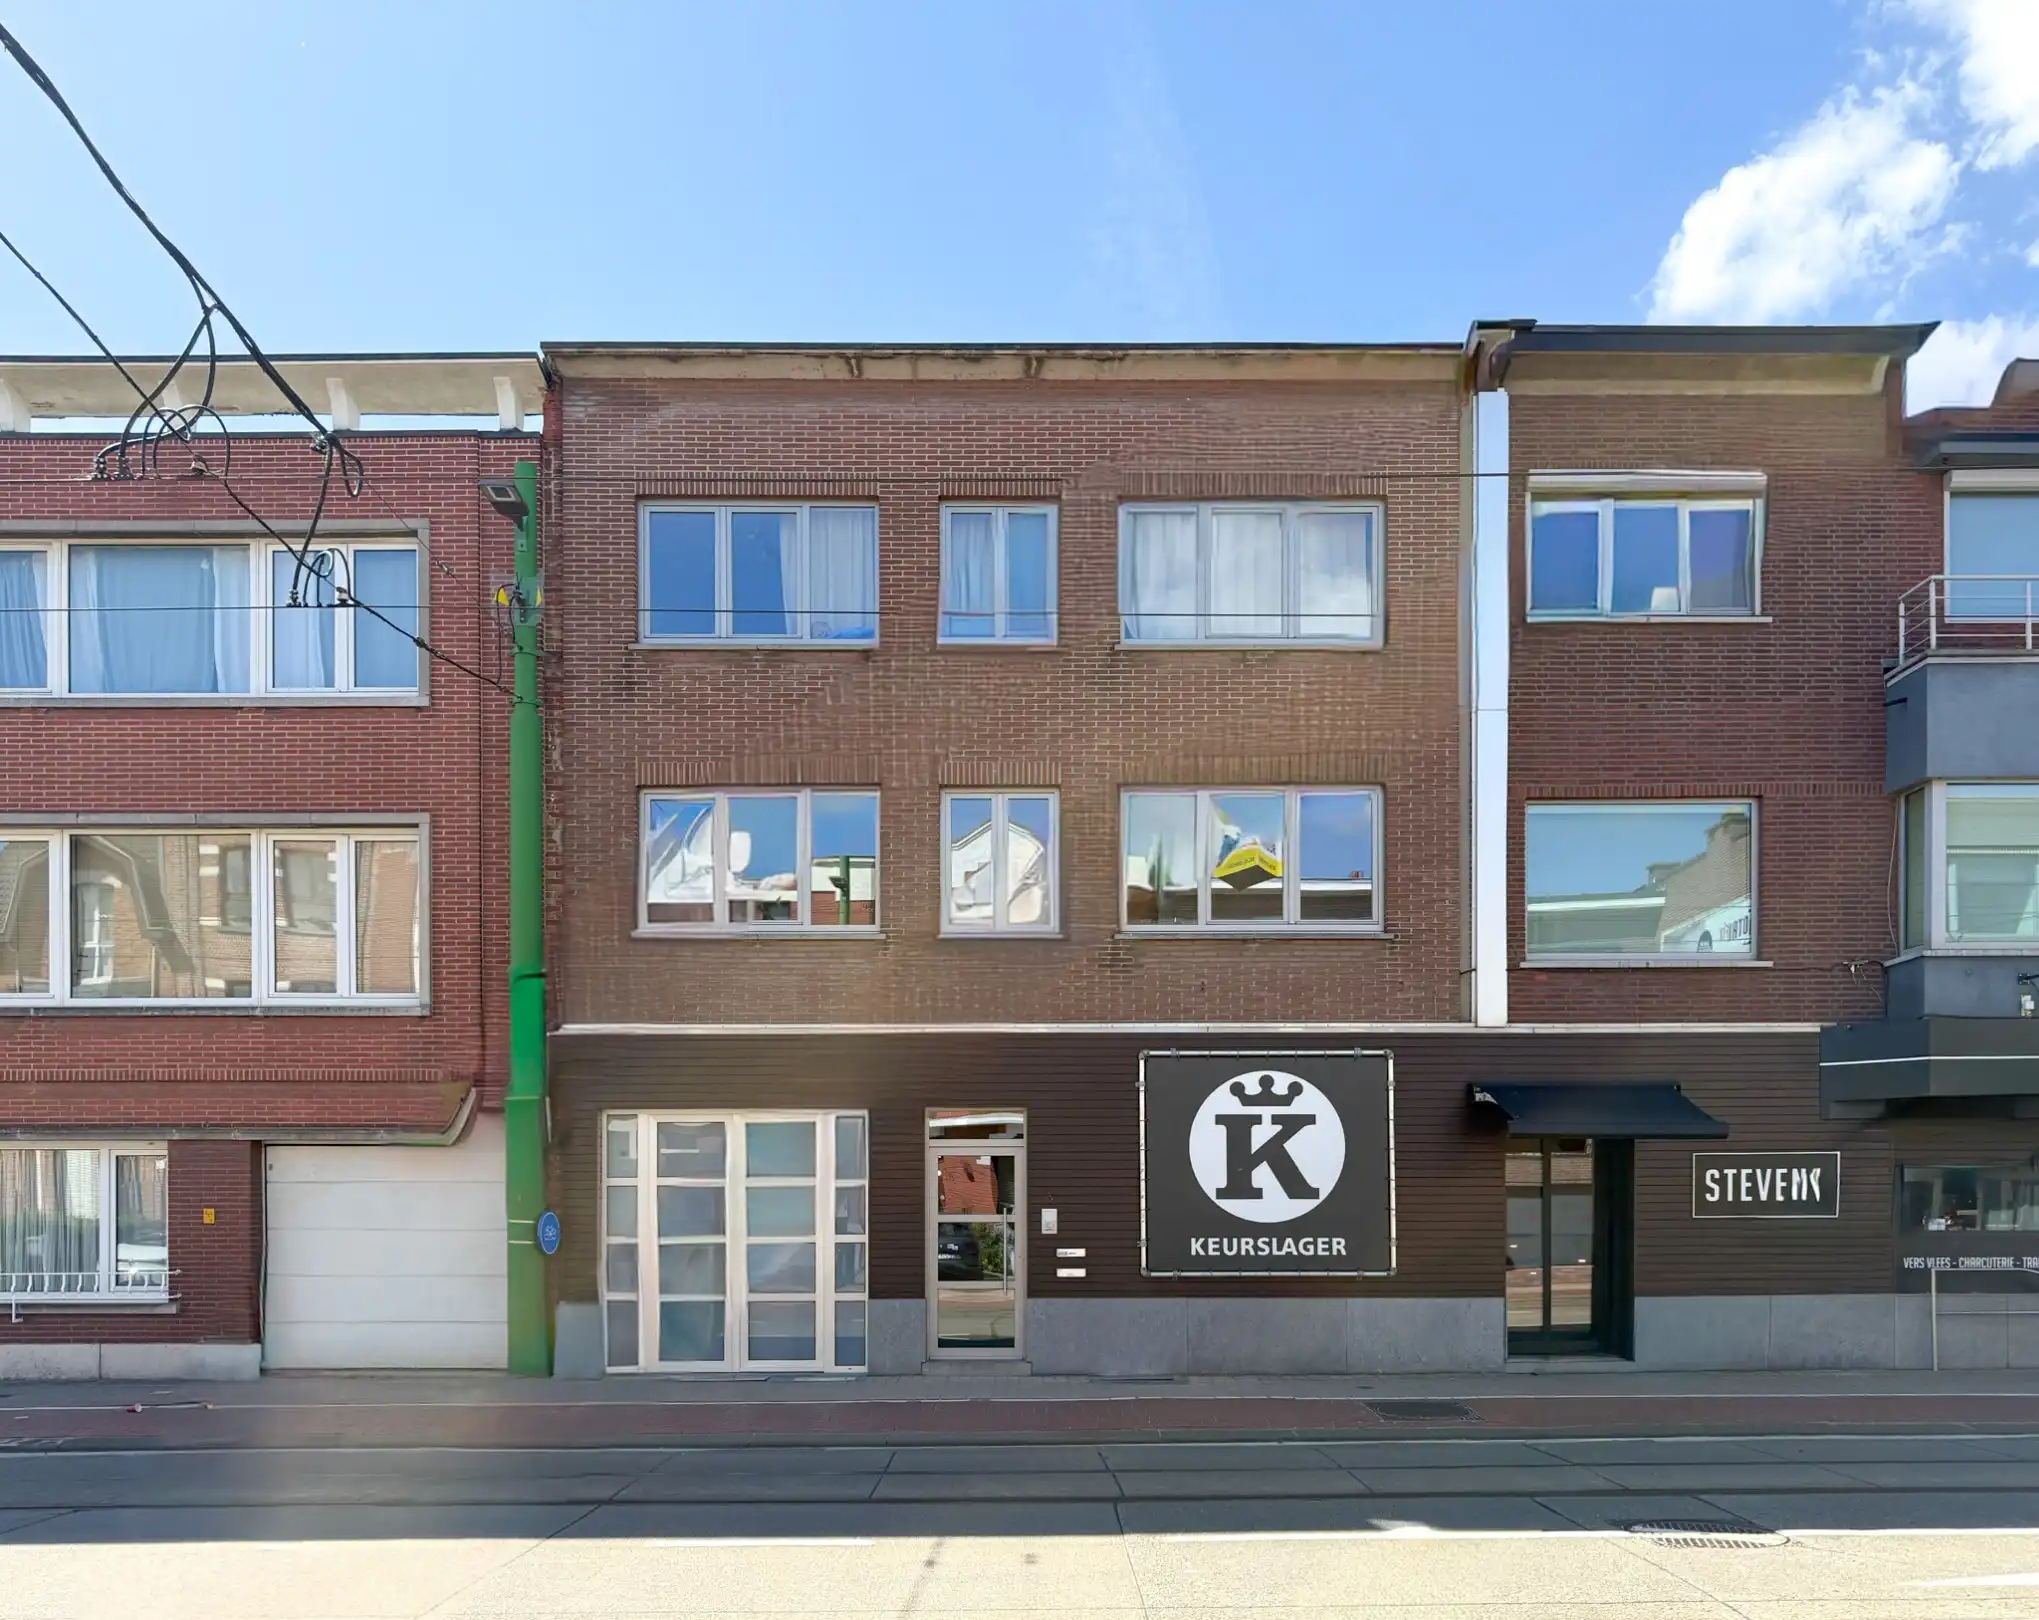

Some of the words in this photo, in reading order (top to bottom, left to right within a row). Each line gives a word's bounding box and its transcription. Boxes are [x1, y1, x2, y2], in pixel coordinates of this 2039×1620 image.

[1214, 1113, 1320, 1200] K
[1190, 1237, 1347, 1256] KEURSLAGER
[1903, 1257, 1925, 1269] VERS
[1926, 1257, 1951, 1269] VLEES
[1958, 1256, 2015, 1268] CHARCUTERIE
